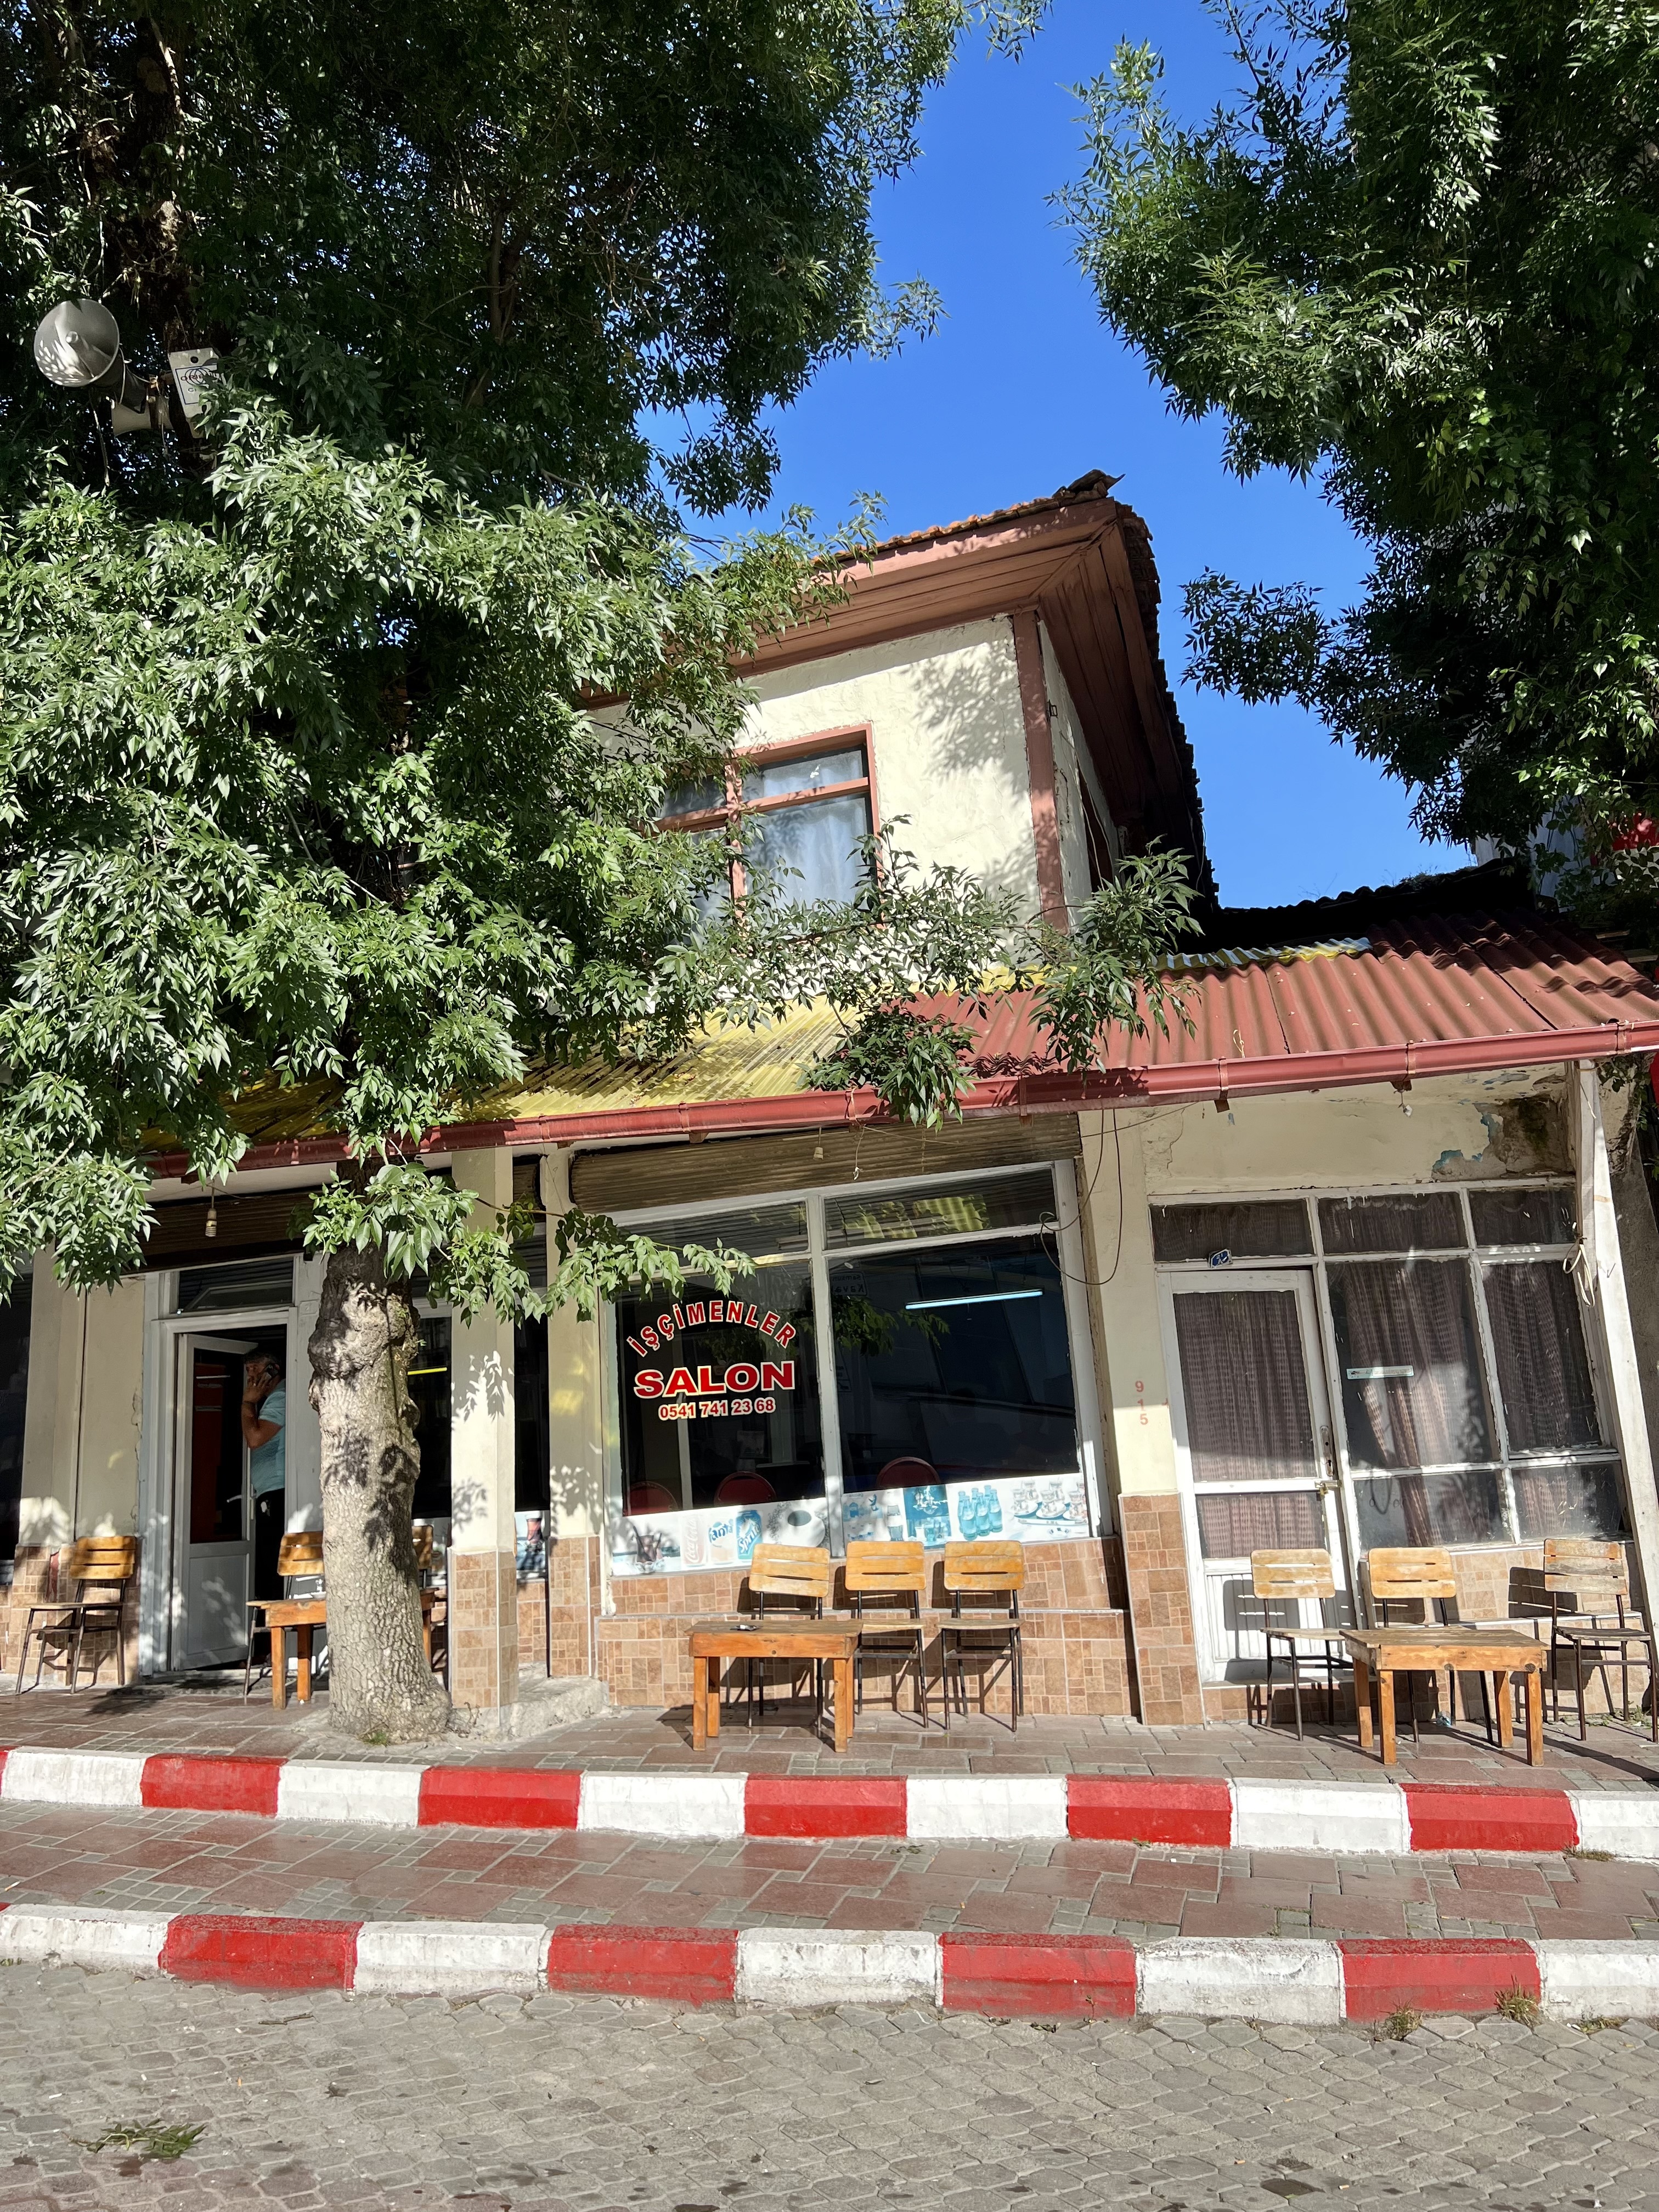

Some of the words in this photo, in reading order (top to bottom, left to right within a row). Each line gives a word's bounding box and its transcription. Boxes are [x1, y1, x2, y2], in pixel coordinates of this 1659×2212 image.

[627, 1300, 796, 1357] İŞÇİMENLER
[634, 1361, 795, 1399] SALON
[658, 1402, 696, 1421] 0541
[699, 1400, 728, 1418] 741
[731, 1398, 753, 1415] 23
[754, 1397, 776, 1414] 68
